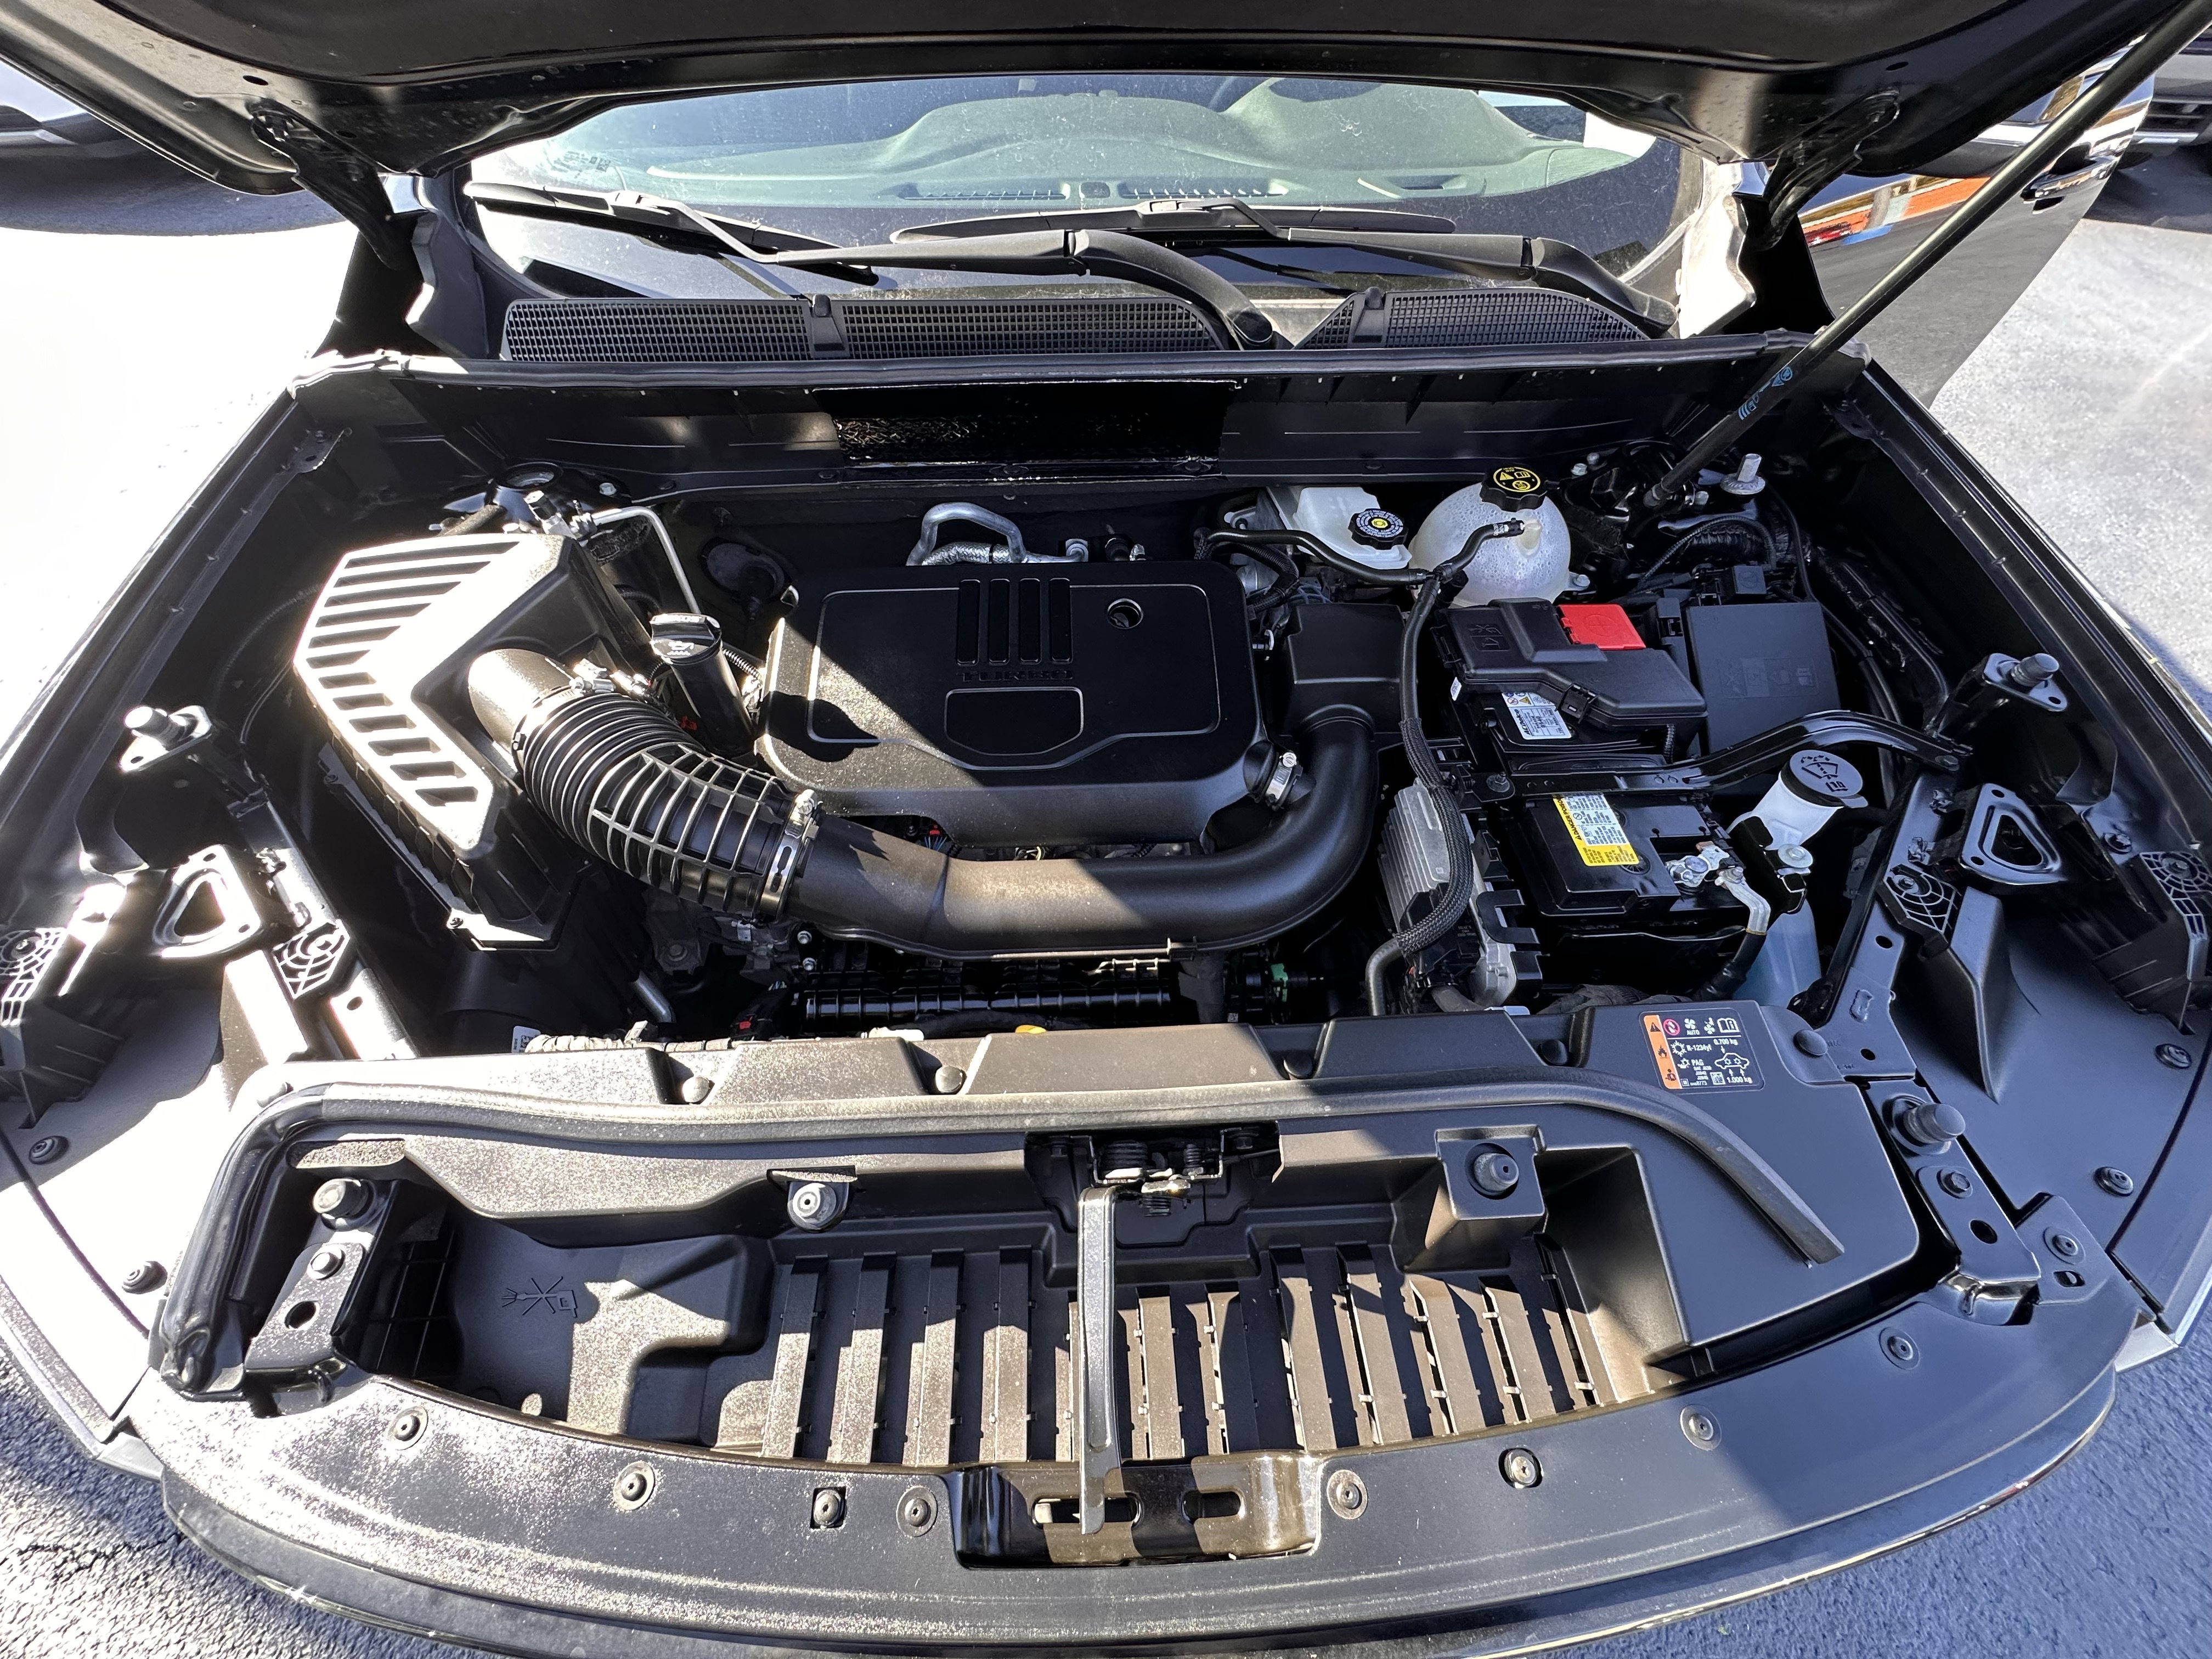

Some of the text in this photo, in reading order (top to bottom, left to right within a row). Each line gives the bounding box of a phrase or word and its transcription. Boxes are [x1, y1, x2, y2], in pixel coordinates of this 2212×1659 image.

[956, 670, 1073, 682] TURBO
[1514, 709, 1531, 736] ACDelco
[1686, 1043, 1712, 1052] R-1234yf
